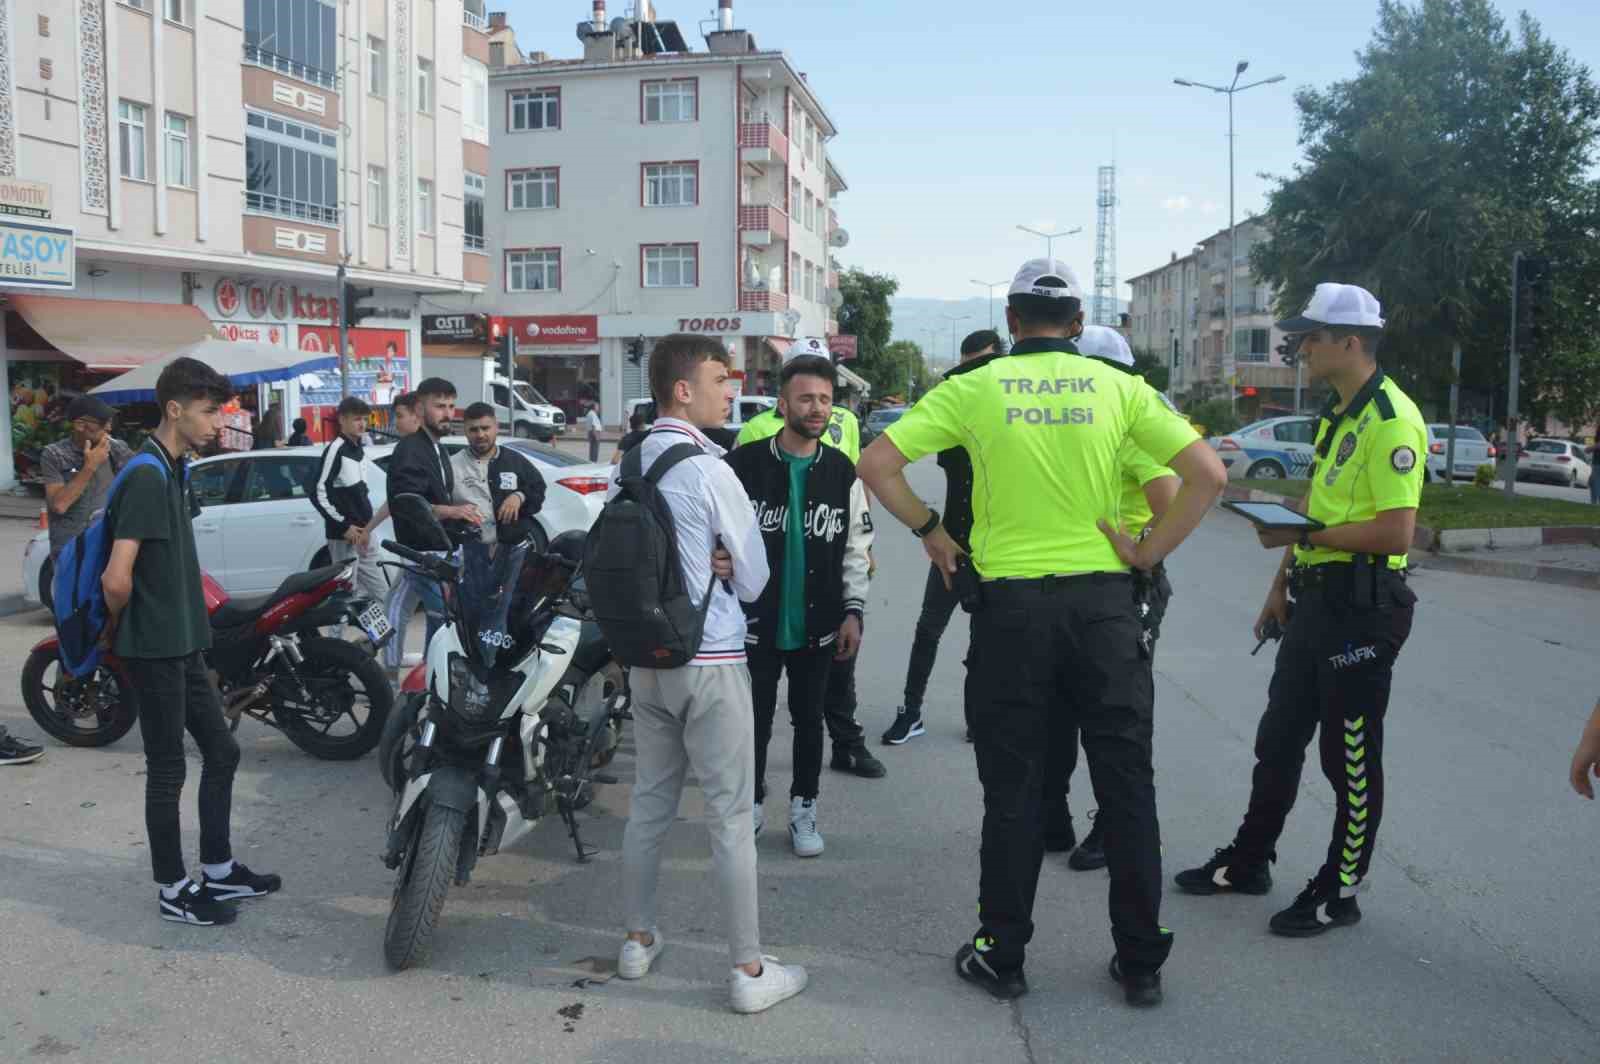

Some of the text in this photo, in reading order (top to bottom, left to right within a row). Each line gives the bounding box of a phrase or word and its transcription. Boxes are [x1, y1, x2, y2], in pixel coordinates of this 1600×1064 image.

[0, 232, 67, 263] ASOY
[541, 324, 588, 336] vodafone
[677, 317, 742, 332] TOROS
